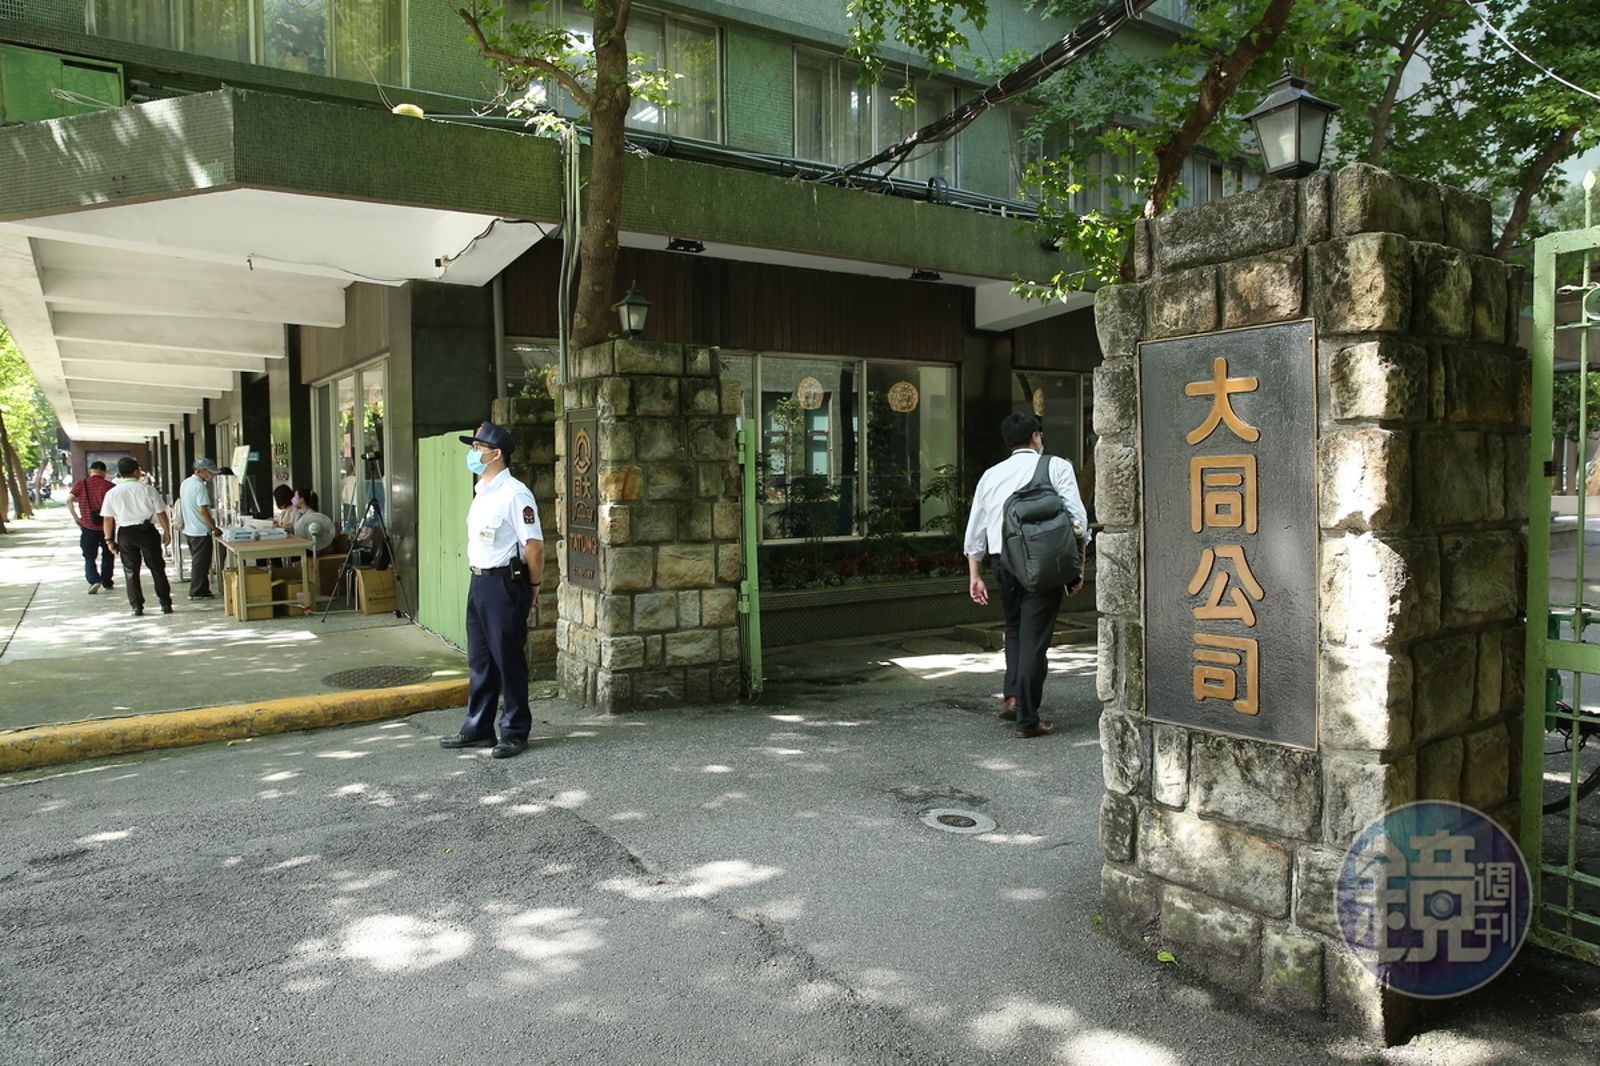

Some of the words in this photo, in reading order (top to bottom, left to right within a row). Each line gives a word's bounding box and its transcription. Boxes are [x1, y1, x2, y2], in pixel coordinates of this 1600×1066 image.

[569, 532, 598, 556] TATUNG
[1185, 357, 1264, 715] 大同公司
